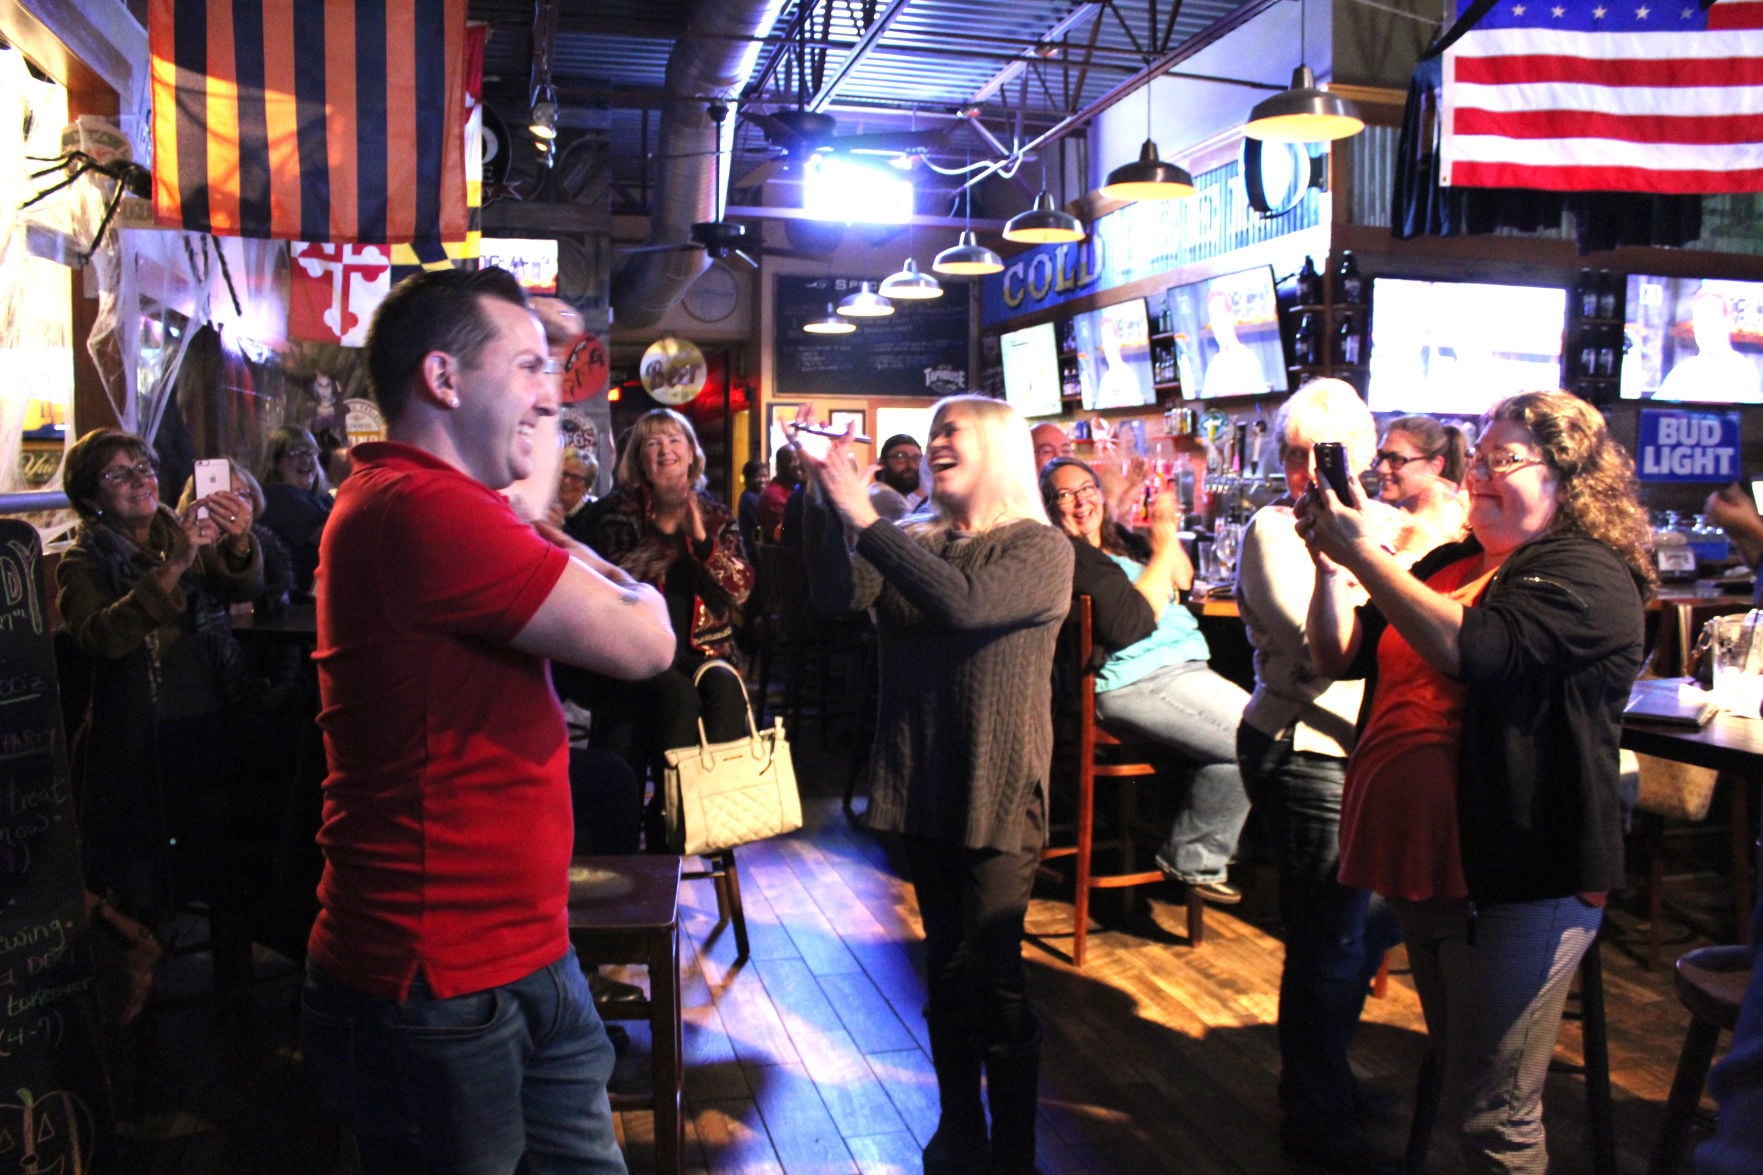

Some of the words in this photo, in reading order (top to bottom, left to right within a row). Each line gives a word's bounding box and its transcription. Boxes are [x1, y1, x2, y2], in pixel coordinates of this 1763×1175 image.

[1003, 235, 1104, 307] COLD
[1658, 416, 1722, 446] BUD
[1643, 446, 1735, 475] LIGHT
